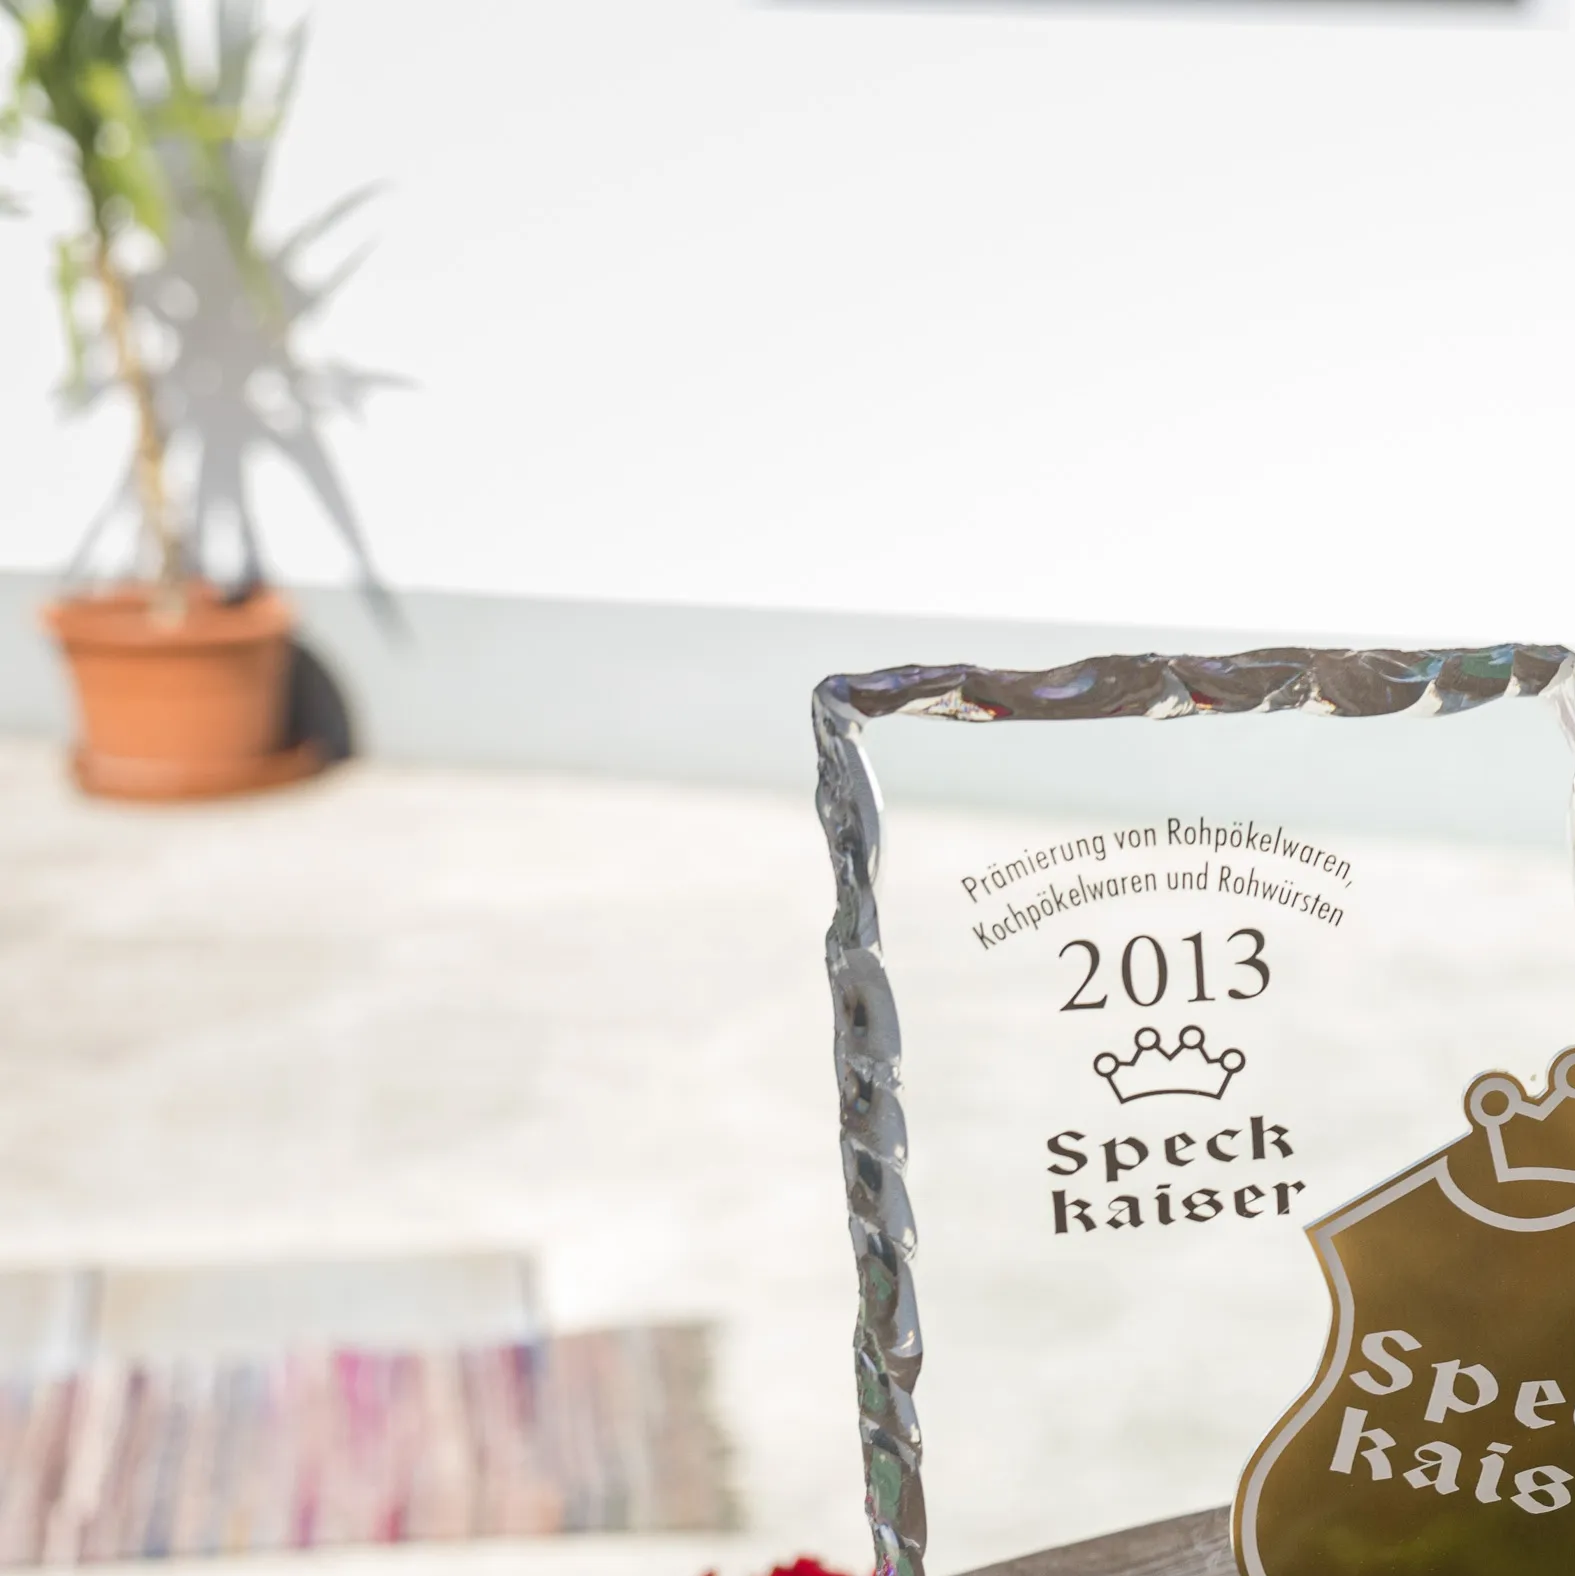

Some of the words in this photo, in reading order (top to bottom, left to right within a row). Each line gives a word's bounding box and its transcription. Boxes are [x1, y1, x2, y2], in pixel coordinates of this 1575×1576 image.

[961, 834, 1106, 903] Prämierung
[1113, 826, 1157, 850] von
[1167, 817, 1354, 889] Rohpökelwaren,
[972, 869, 1158, 951] Kochpökelwaren
[1166, 861, 1209, 891] und
[1218, 865, 1344, 927] Rohwürsten
[1058, 927, 1272, 1013] 2013
[1045, 1115, 1297, 1184] Speck
[1052, 1176, 1307, 1236] kaiser
